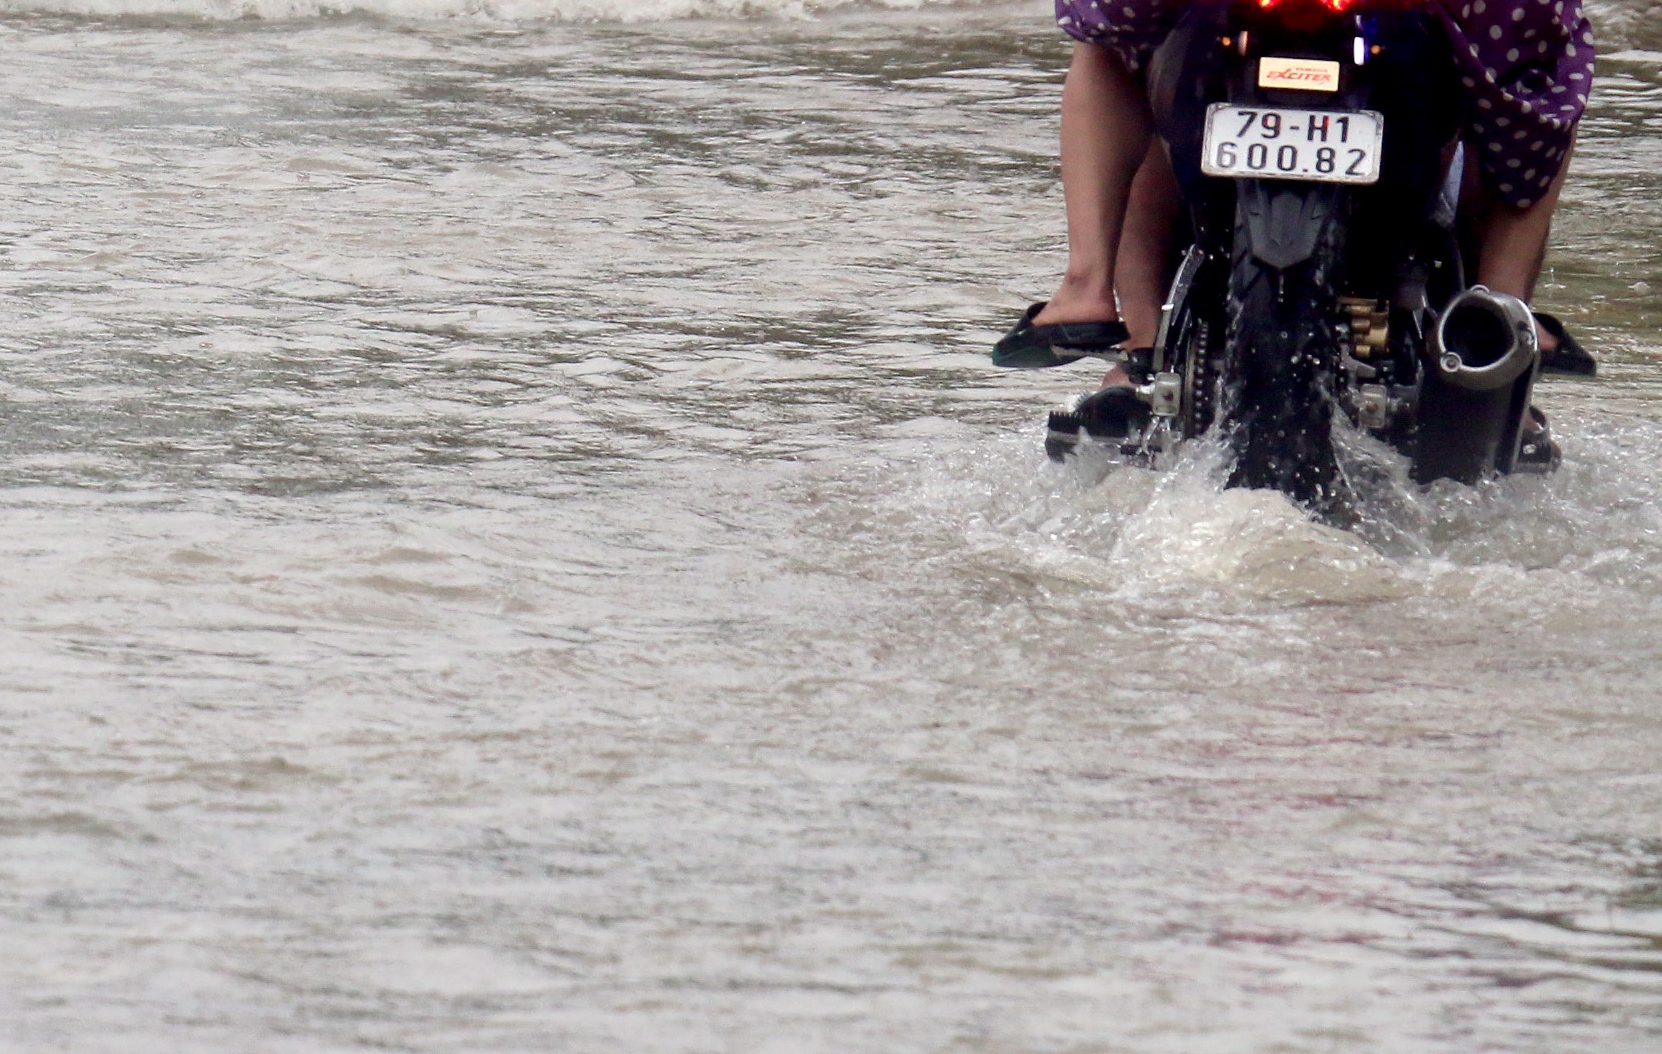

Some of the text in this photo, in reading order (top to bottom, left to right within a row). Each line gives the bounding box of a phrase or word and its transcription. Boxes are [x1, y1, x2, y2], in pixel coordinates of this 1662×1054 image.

[1266, 67, 1332, 84] EXCITER
[1236, 110, 1351, 144] 79-H1
[1216, 140, 1367, 177] 600.82
